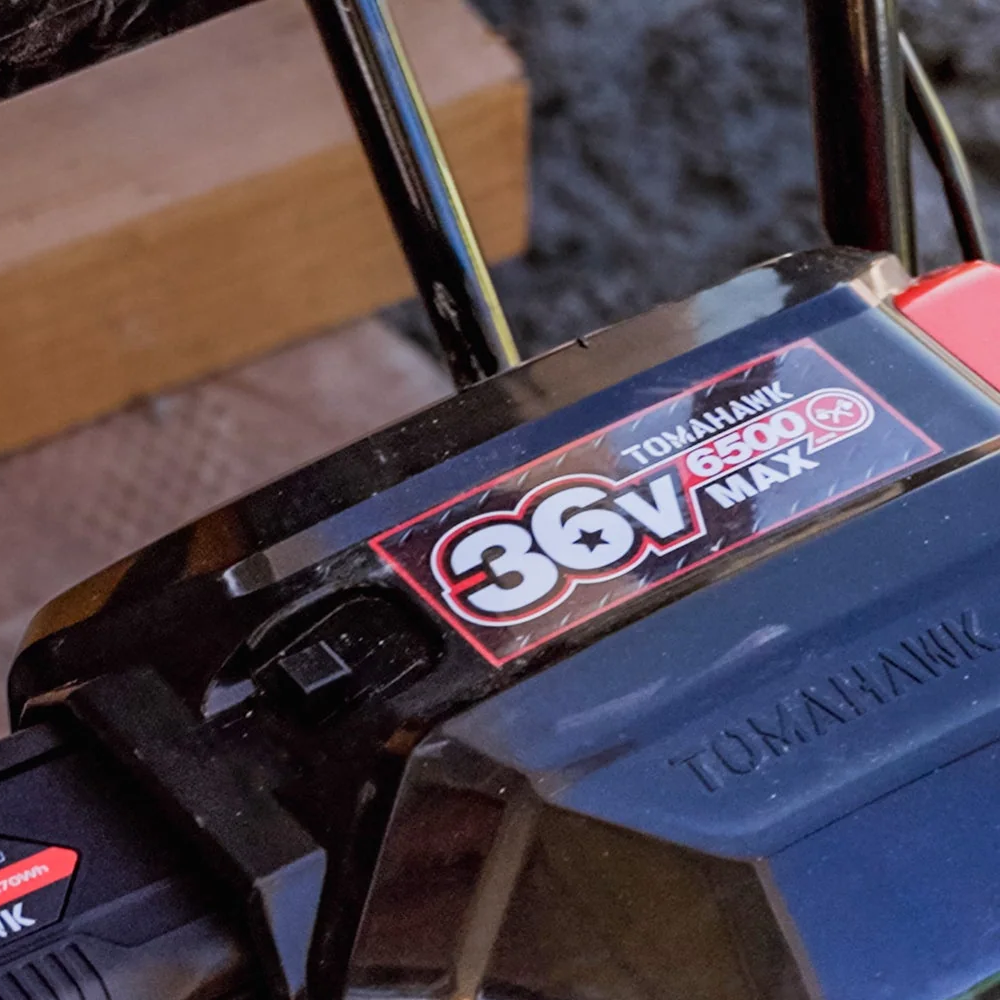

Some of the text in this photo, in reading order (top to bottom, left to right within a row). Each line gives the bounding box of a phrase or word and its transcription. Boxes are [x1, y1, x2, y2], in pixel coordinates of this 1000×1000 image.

[621, 380, 795, 466] TOMAHAWK
[686, 410, 807, 478] 6500
[705, 445, 820, 509] MAX
[668, 608, 998, 793] TOMAHAWK
